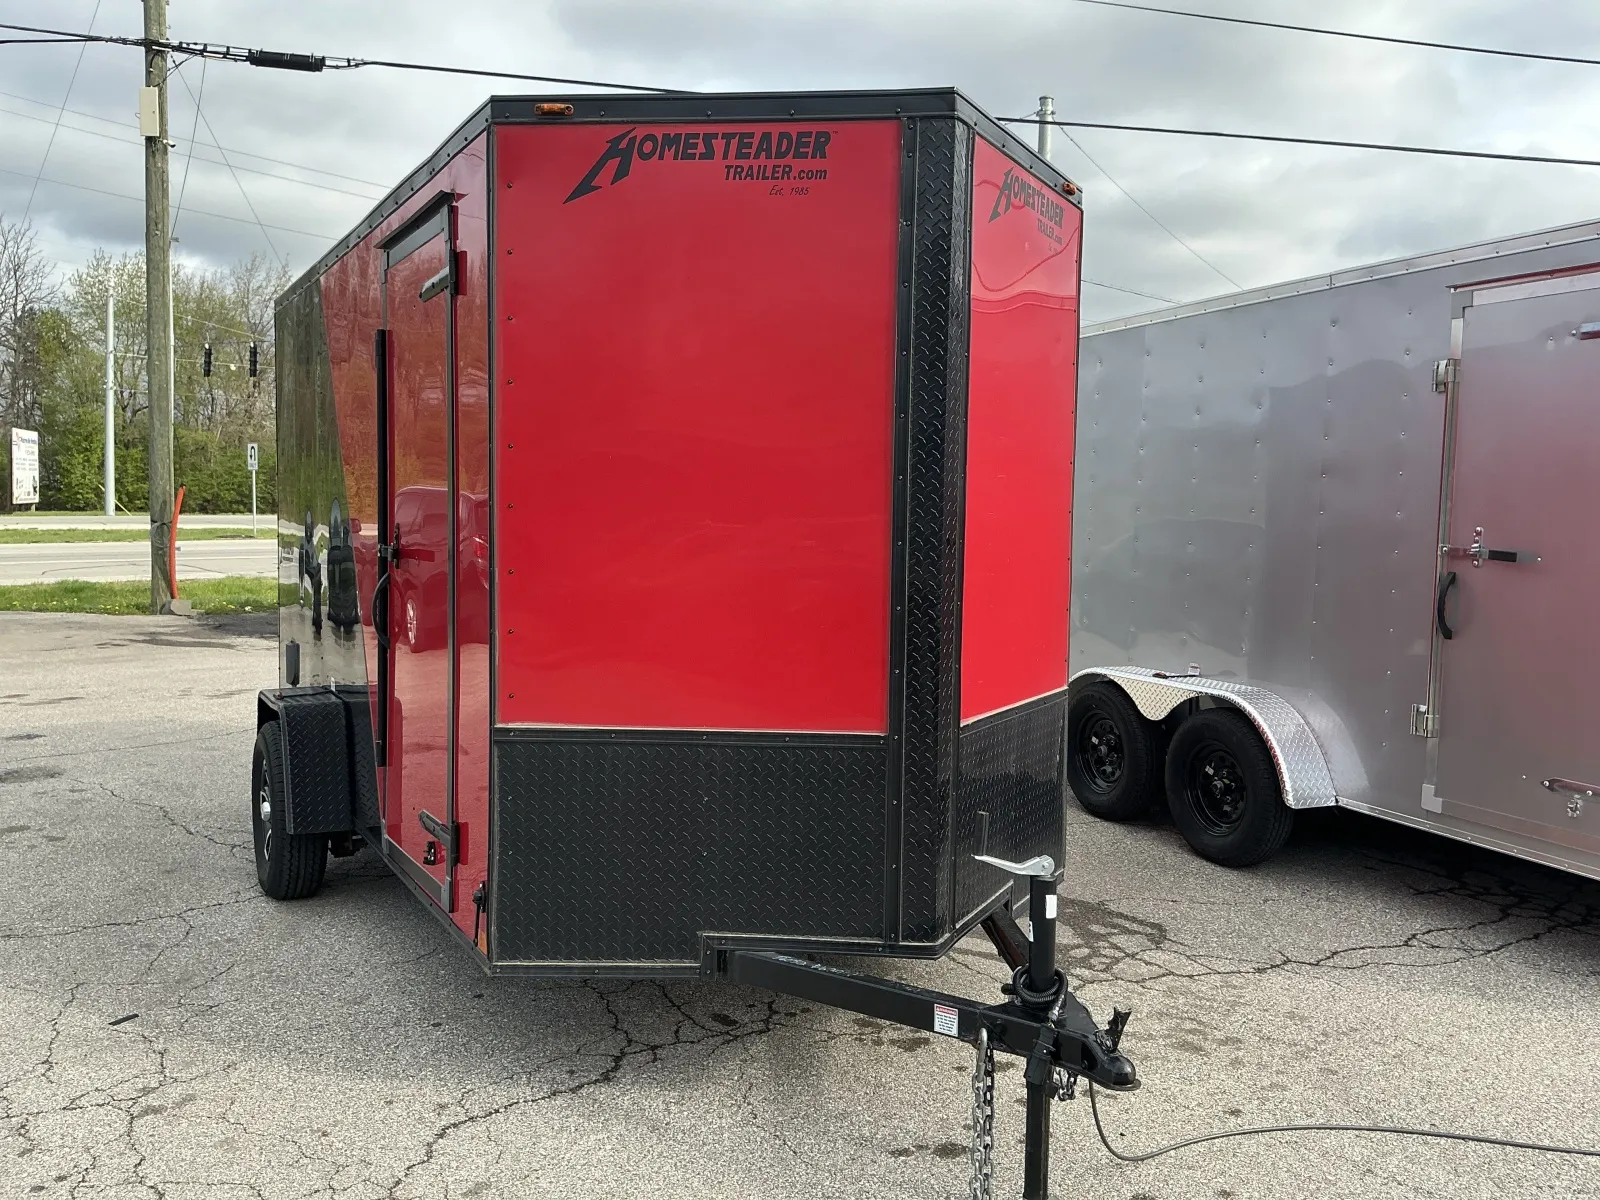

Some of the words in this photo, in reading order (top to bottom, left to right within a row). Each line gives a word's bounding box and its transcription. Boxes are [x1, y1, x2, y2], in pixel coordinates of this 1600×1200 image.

[563, 126, 831, 204] HOMESTEADER
[724, 164, 828, 181] TRAILER.com
[789, 186, 810, 196] 1985
[988, 166, 1064, 230] HOMESTEADER
